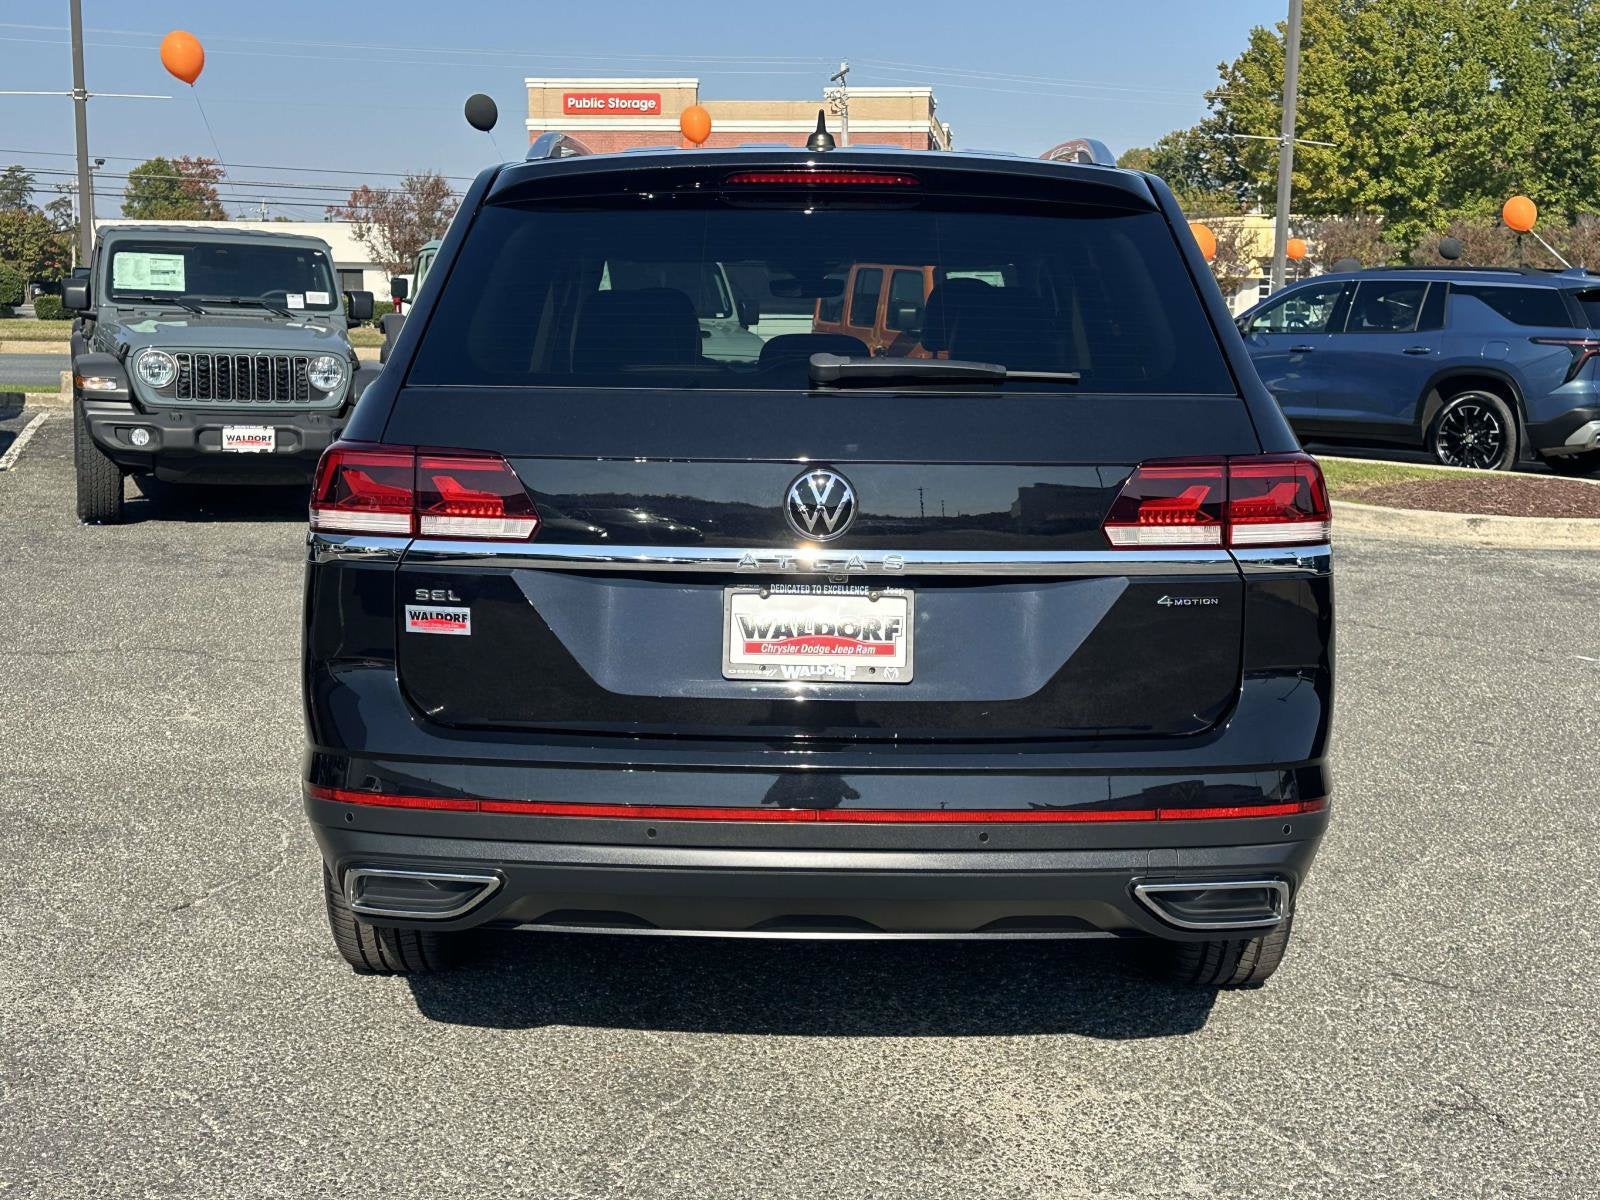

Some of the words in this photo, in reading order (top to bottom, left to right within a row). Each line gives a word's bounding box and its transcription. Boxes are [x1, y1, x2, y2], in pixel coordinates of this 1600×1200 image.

[567, 97, 605, 108] Public
[608, 97, 656, 111] Storage
[736, 553, 905, 571] ATLAS
[415, 588, 462, 602] SEL
[770, 583, 811, 594] DEDICATED
[813, 584, 822, 594] TO
[823, 585, 870, 595] EXCELLENCE
[408, 610, 469, 623] WALDORF
[736, 614, 902, 641] WALDORF
[760, 643, 799, 655] Chrysler
[800, 644, 830, 655] Dodge
[831, 645, 854, 655] Jeep
[855, 645, 876, 654] Ram
[780, 664, 857, 681] WALDORF
